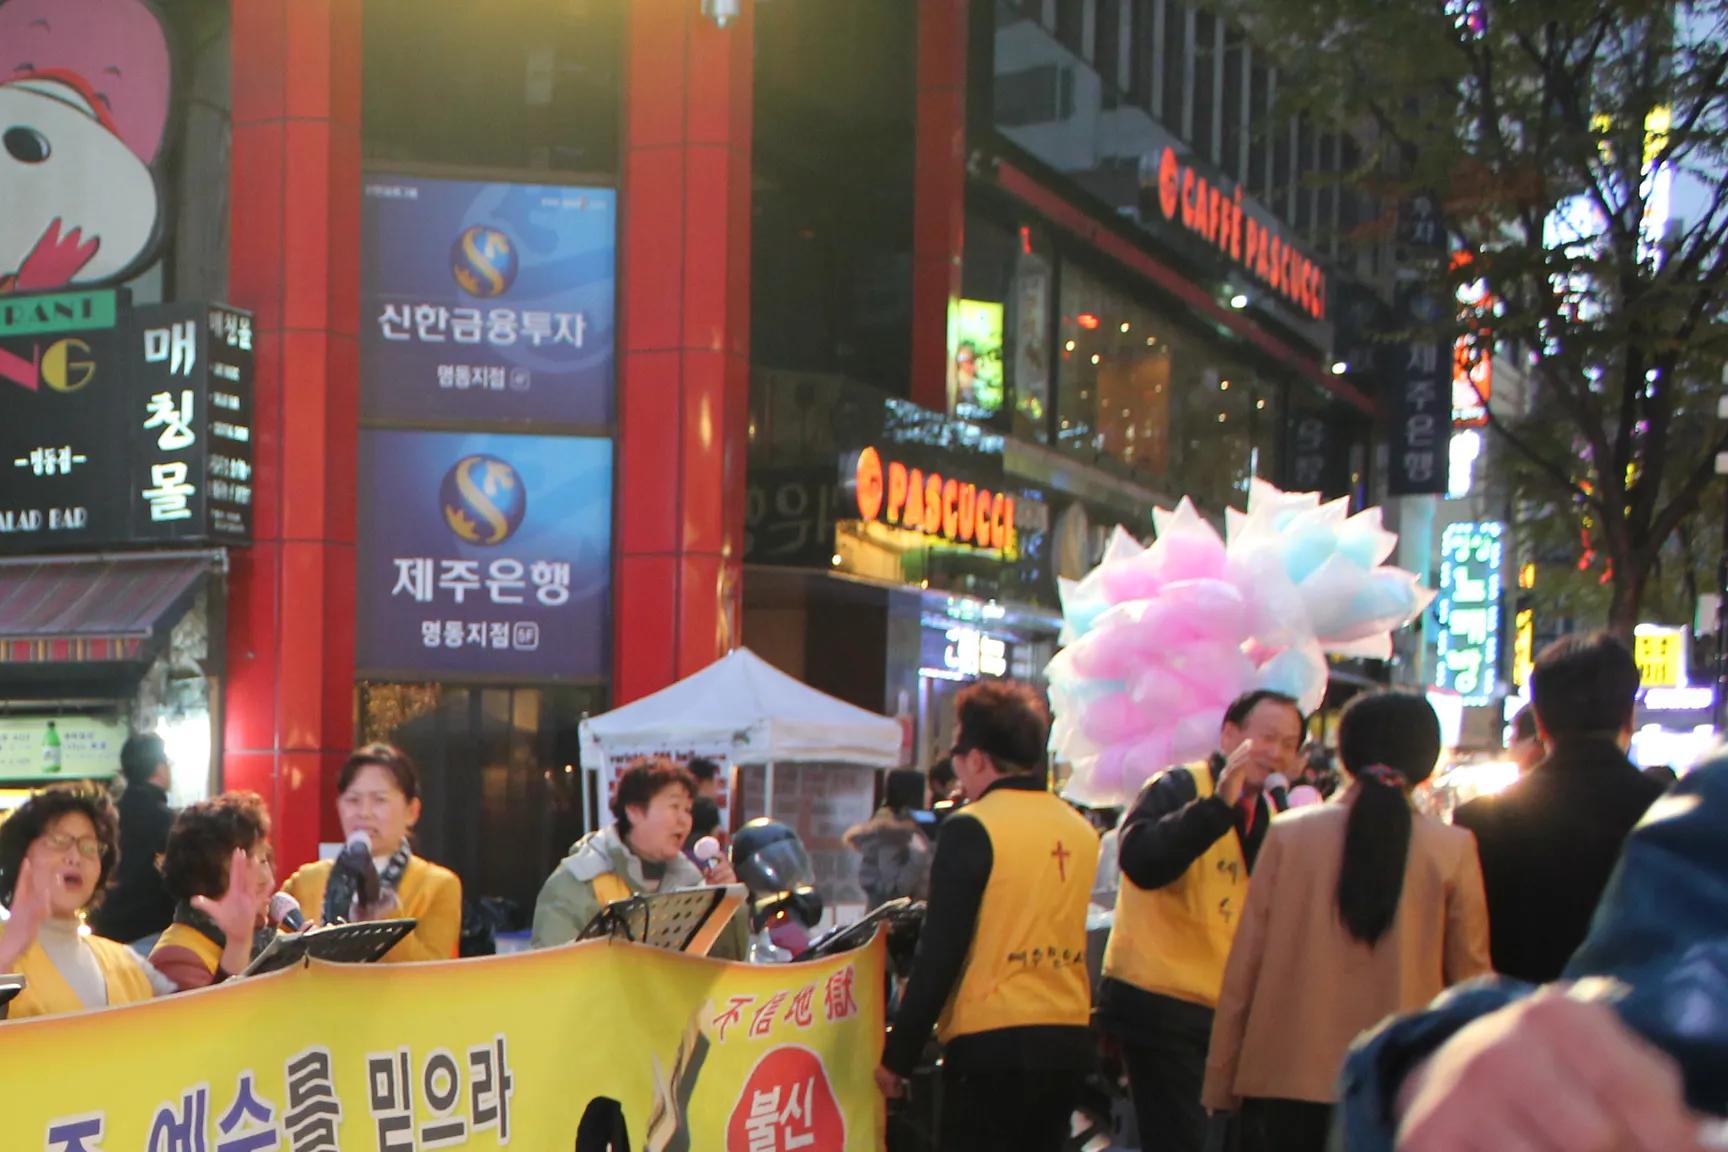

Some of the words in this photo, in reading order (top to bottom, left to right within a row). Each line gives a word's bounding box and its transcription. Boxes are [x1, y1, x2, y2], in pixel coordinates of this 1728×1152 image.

[1181, 166, 1243, 262] CAFFÉ
[1245, 216, 1325, 320] PASCUCCI
[378, 304, 585, 348] 신한금융투자
[142, 320, 196, 522] 매칭몰
[49, 506, 87, 531] BAR
[887, 461, 1015, 548] PASCUCCI
[391, 557, 571, 606] 제주은행
[422, 620, 510, 649] 명동지점
[713, 965, 858, 1041] 不信地獄
